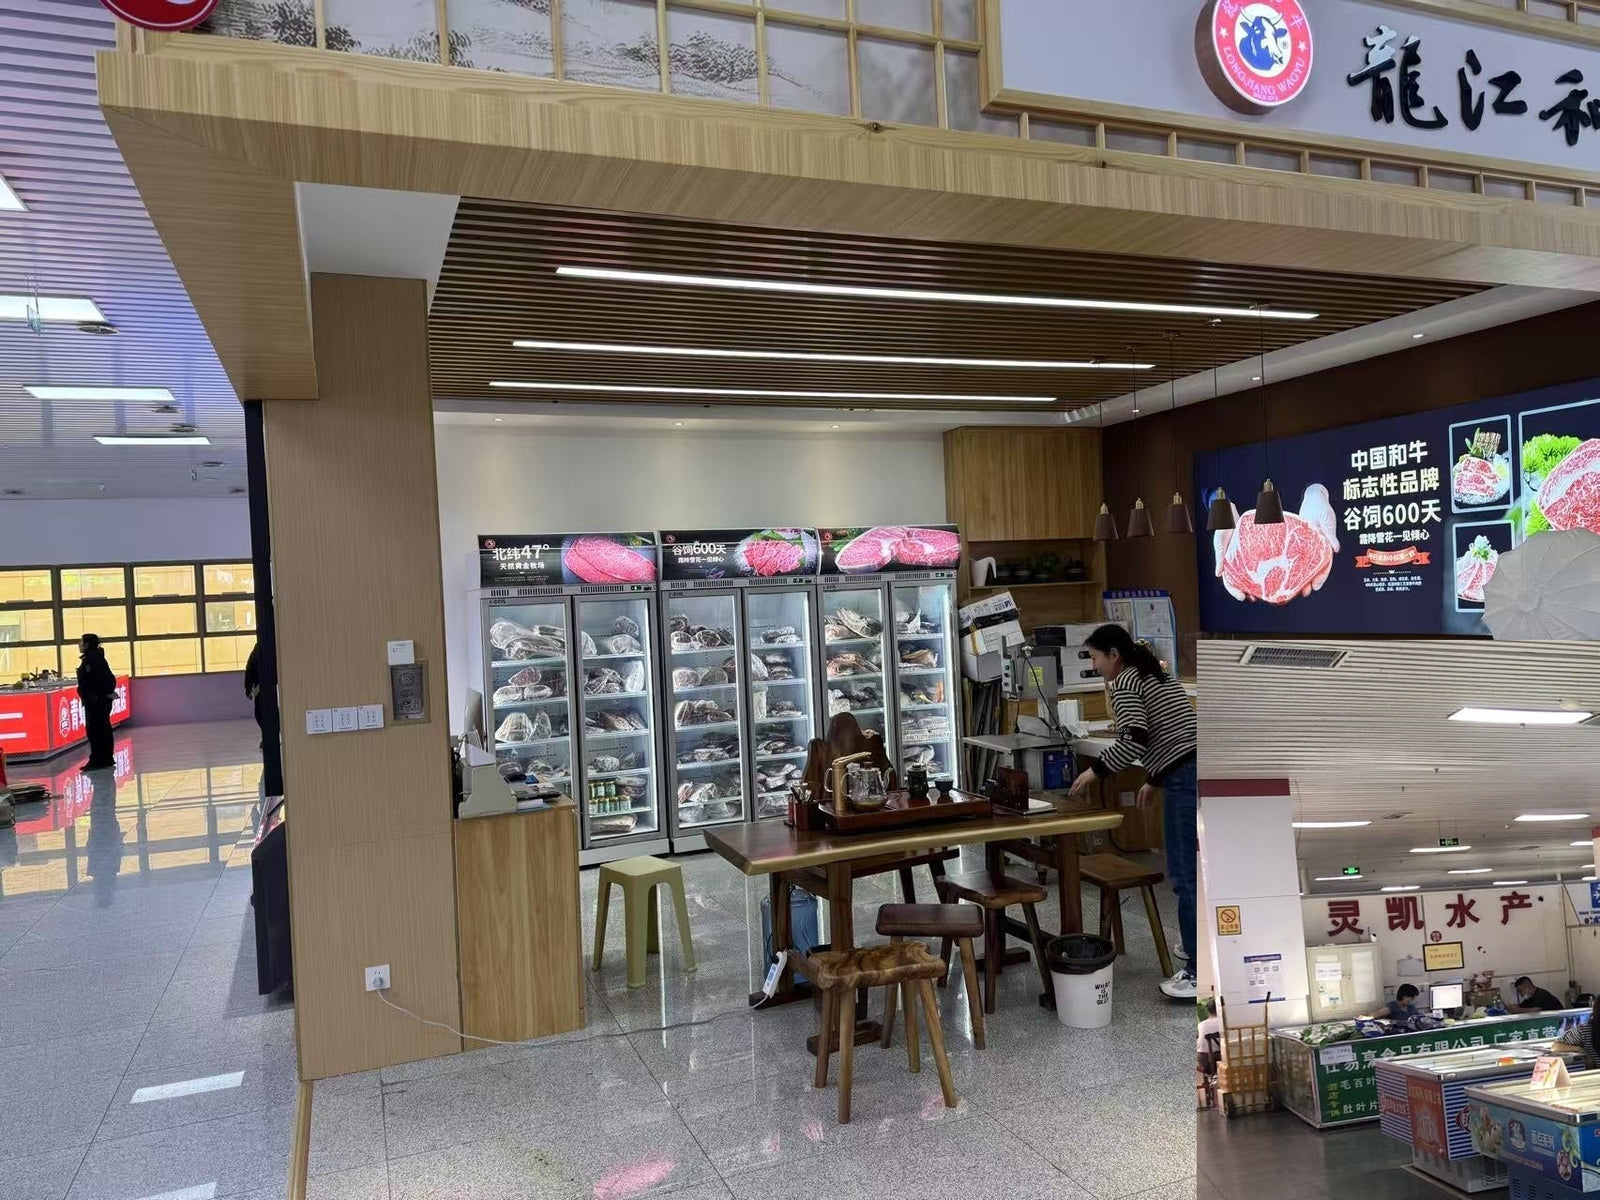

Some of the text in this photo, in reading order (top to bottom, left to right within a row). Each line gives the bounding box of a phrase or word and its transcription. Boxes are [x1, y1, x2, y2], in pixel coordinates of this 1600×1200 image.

[1277, 57, 1305, 93] WAGYU
[1350, 439, 1428, 472] 中国和牛
[1342, 466, 1440, 501] 标志性品牌
[1343, 498, 1442, 532] 谷饲600天
[492, 543, 550, 561] 北纬47°
[499, 561, 545, 570] 天然黄金牧场
[672, 542, 727, 556] 谷饲600天
[1327, 891, 1533, 937] 灵凯水产
